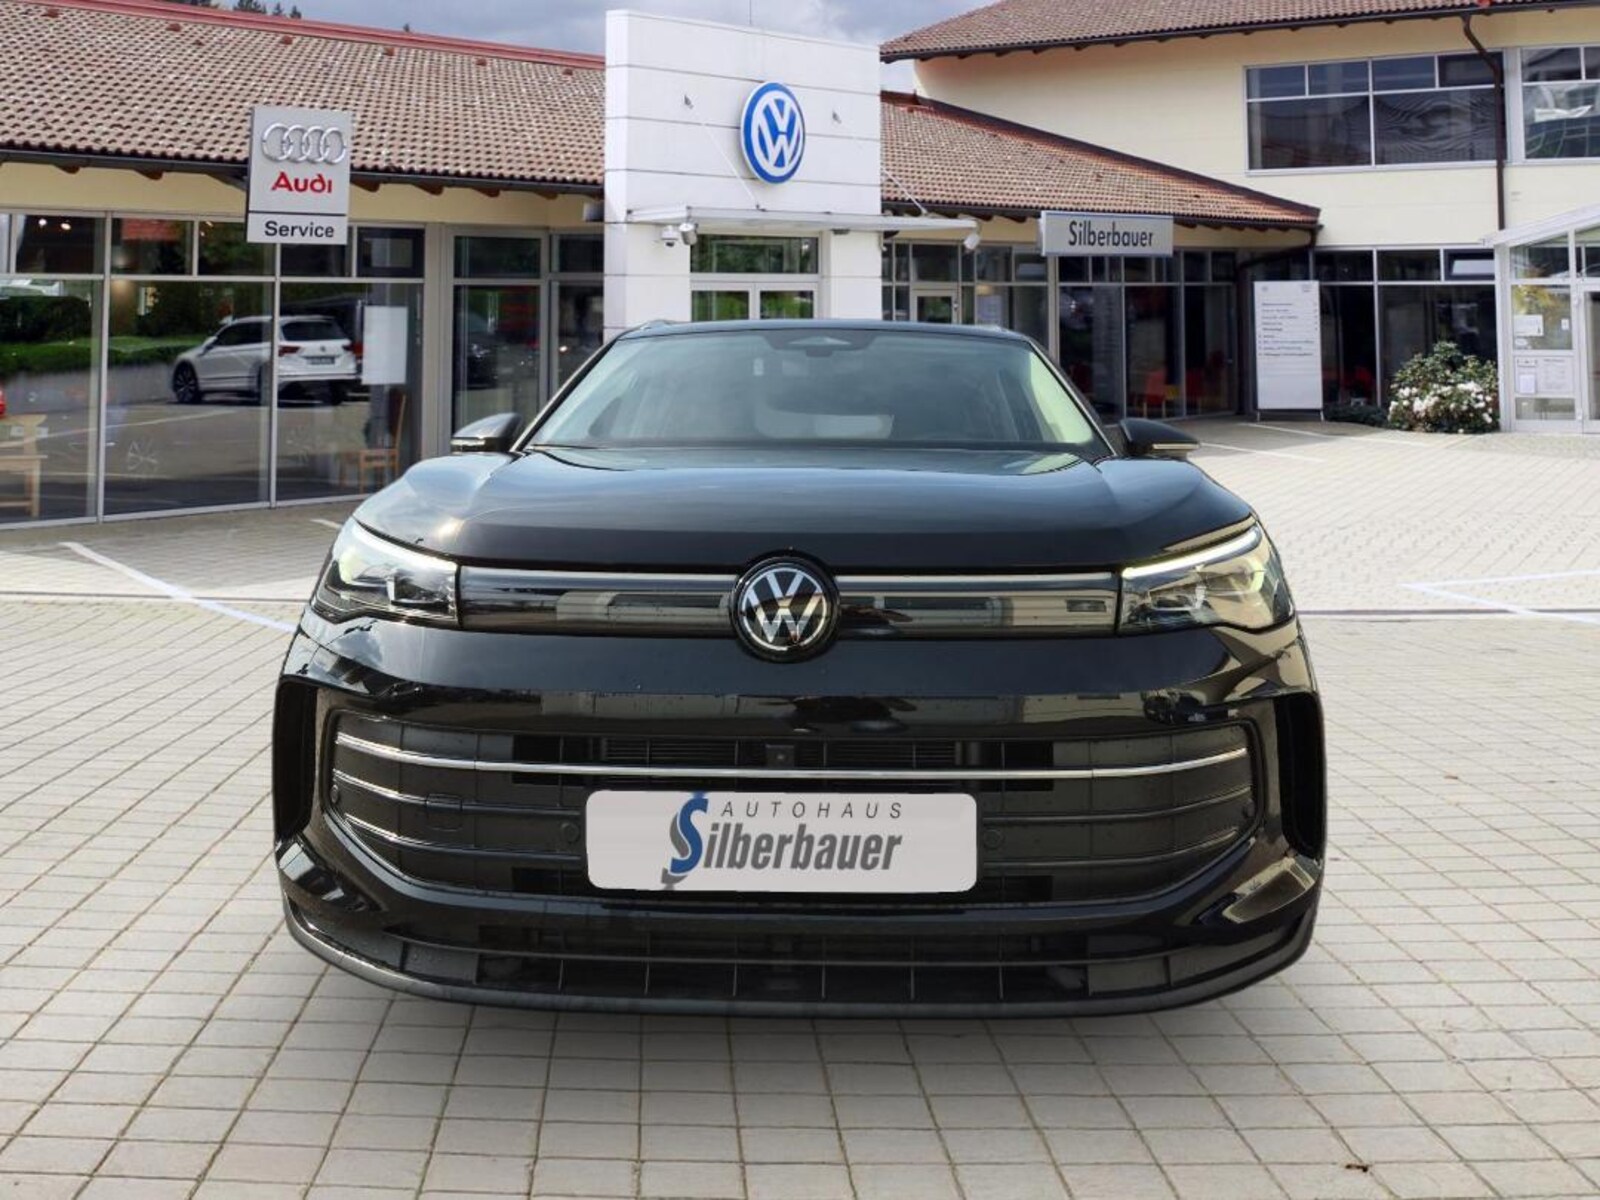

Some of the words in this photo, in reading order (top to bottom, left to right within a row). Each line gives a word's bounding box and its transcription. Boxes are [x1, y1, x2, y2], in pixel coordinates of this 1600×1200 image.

[271, 171, 332, 193] Audi
[264, 220, 335, 238] Service
[1068, 220, 1154, 247] Silberbauer
[720, 801, 903, 819] AUTOHAUS
[664, 793, 903, 877] Silberbauer
